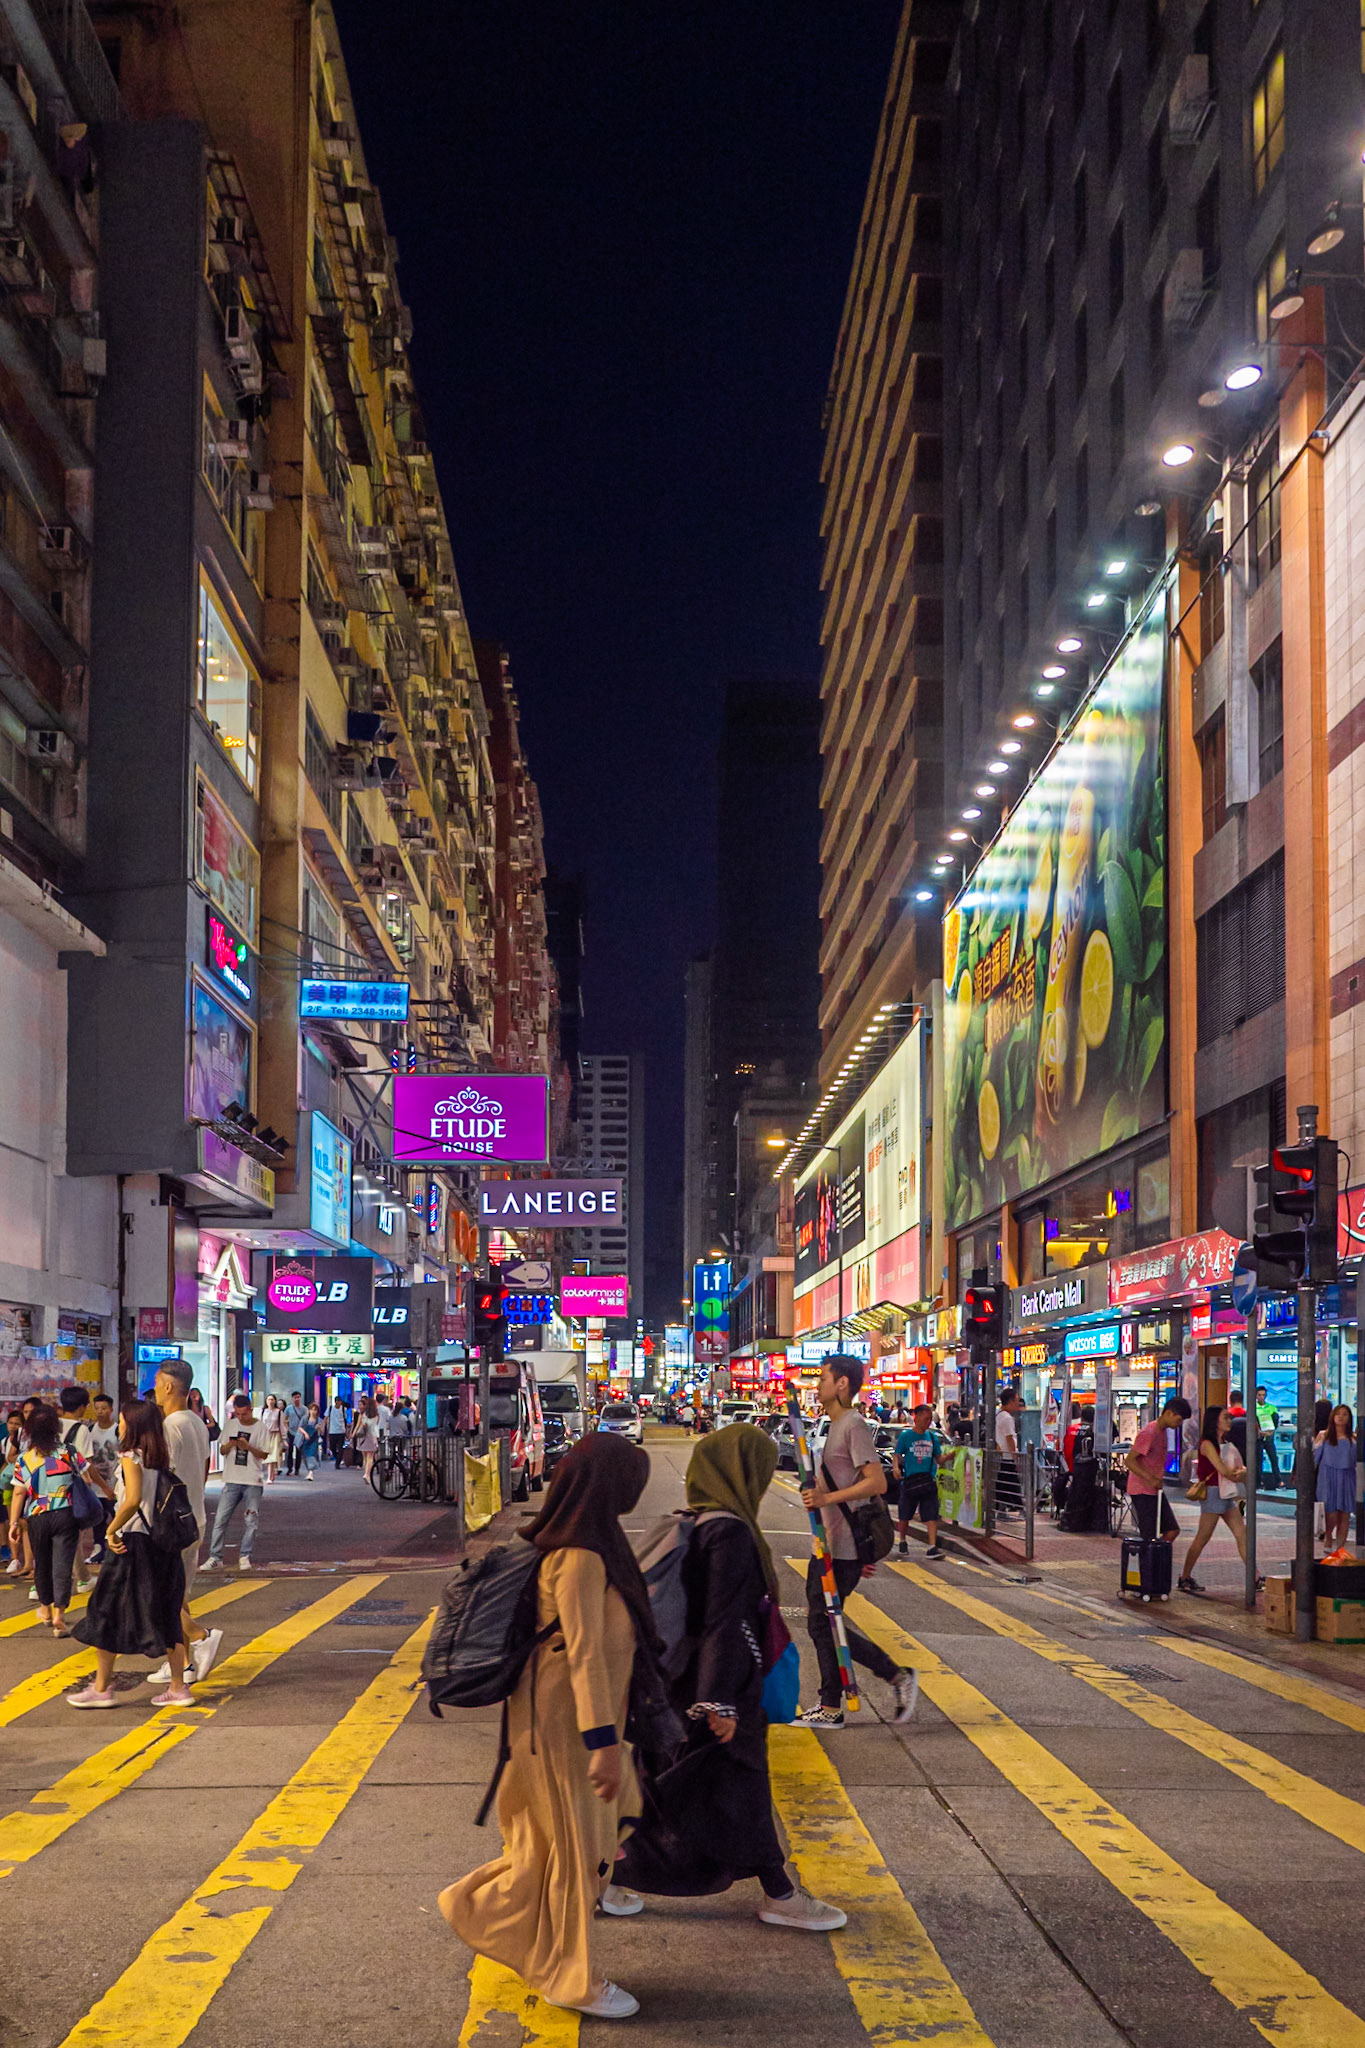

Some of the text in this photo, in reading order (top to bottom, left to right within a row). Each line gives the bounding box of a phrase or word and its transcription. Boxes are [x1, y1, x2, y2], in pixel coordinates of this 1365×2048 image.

[330, 1006, 348, 1015] Tel:
[351, 1007, 402, 1017] 2348-3168
[430, 1118, 506, 1138] ETUDE
[442, 1141, 493, 1153] HOUSE
[482, 1191, 617, 1215] LANEIGE
[275, 1284, 311, 1296] ETUDE
[703, 1271, 721, 1291] i.t
[280, 1295, 305, 1303] HOUSE
[315, 1281, 349, 1302] LB
[1021, 1280, 1081, 1318] Bank Centre Mall
[270, 1336, 366, 1355] 田園書屋
[1068, 1336, 1097, 1352] watsons
[1021, 1344, 1045, 1365] FORTRESS
